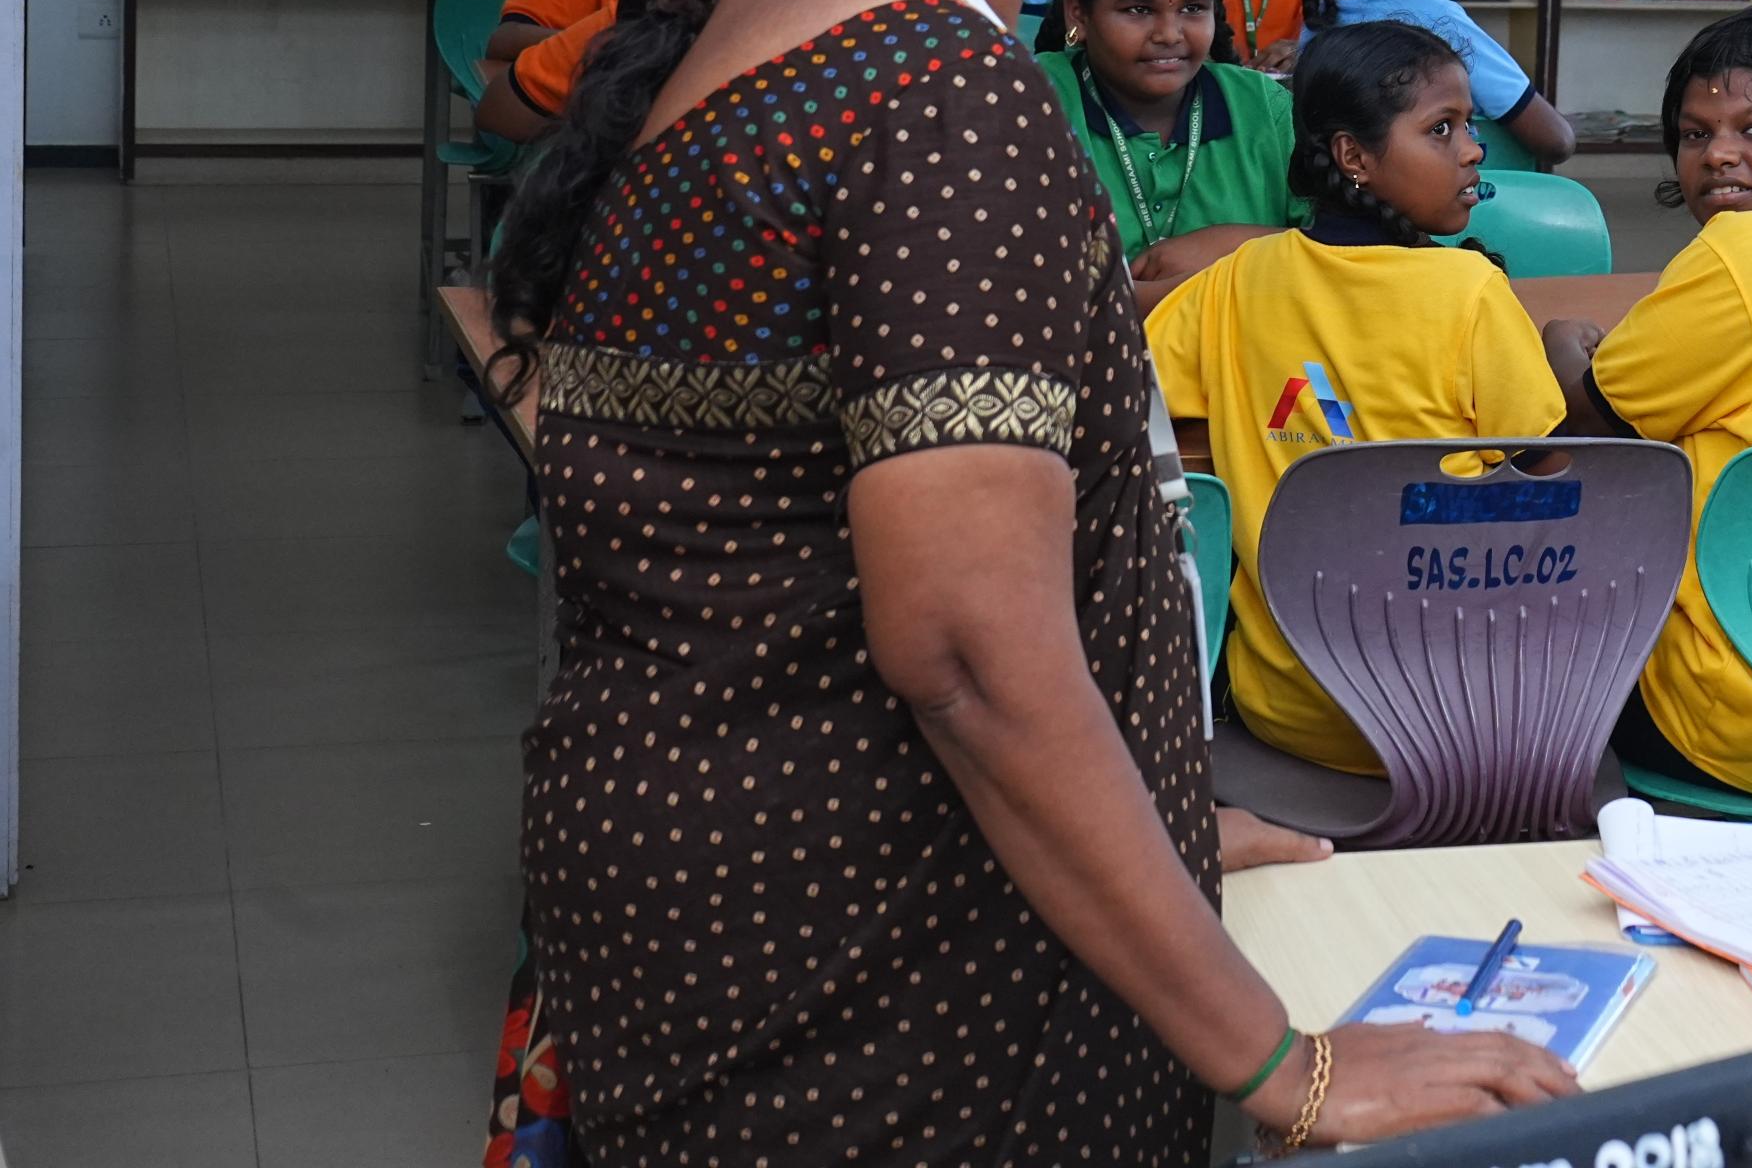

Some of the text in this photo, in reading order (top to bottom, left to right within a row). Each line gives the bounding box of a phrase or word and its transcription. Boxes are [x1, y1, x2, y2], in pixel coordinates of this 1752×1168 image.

[1124, 154, 1144, 200] ABIRAAMI
[1139, 202, 1153, 227] SREE
[1407, 544, 1578, 590] SAS.LC.02
